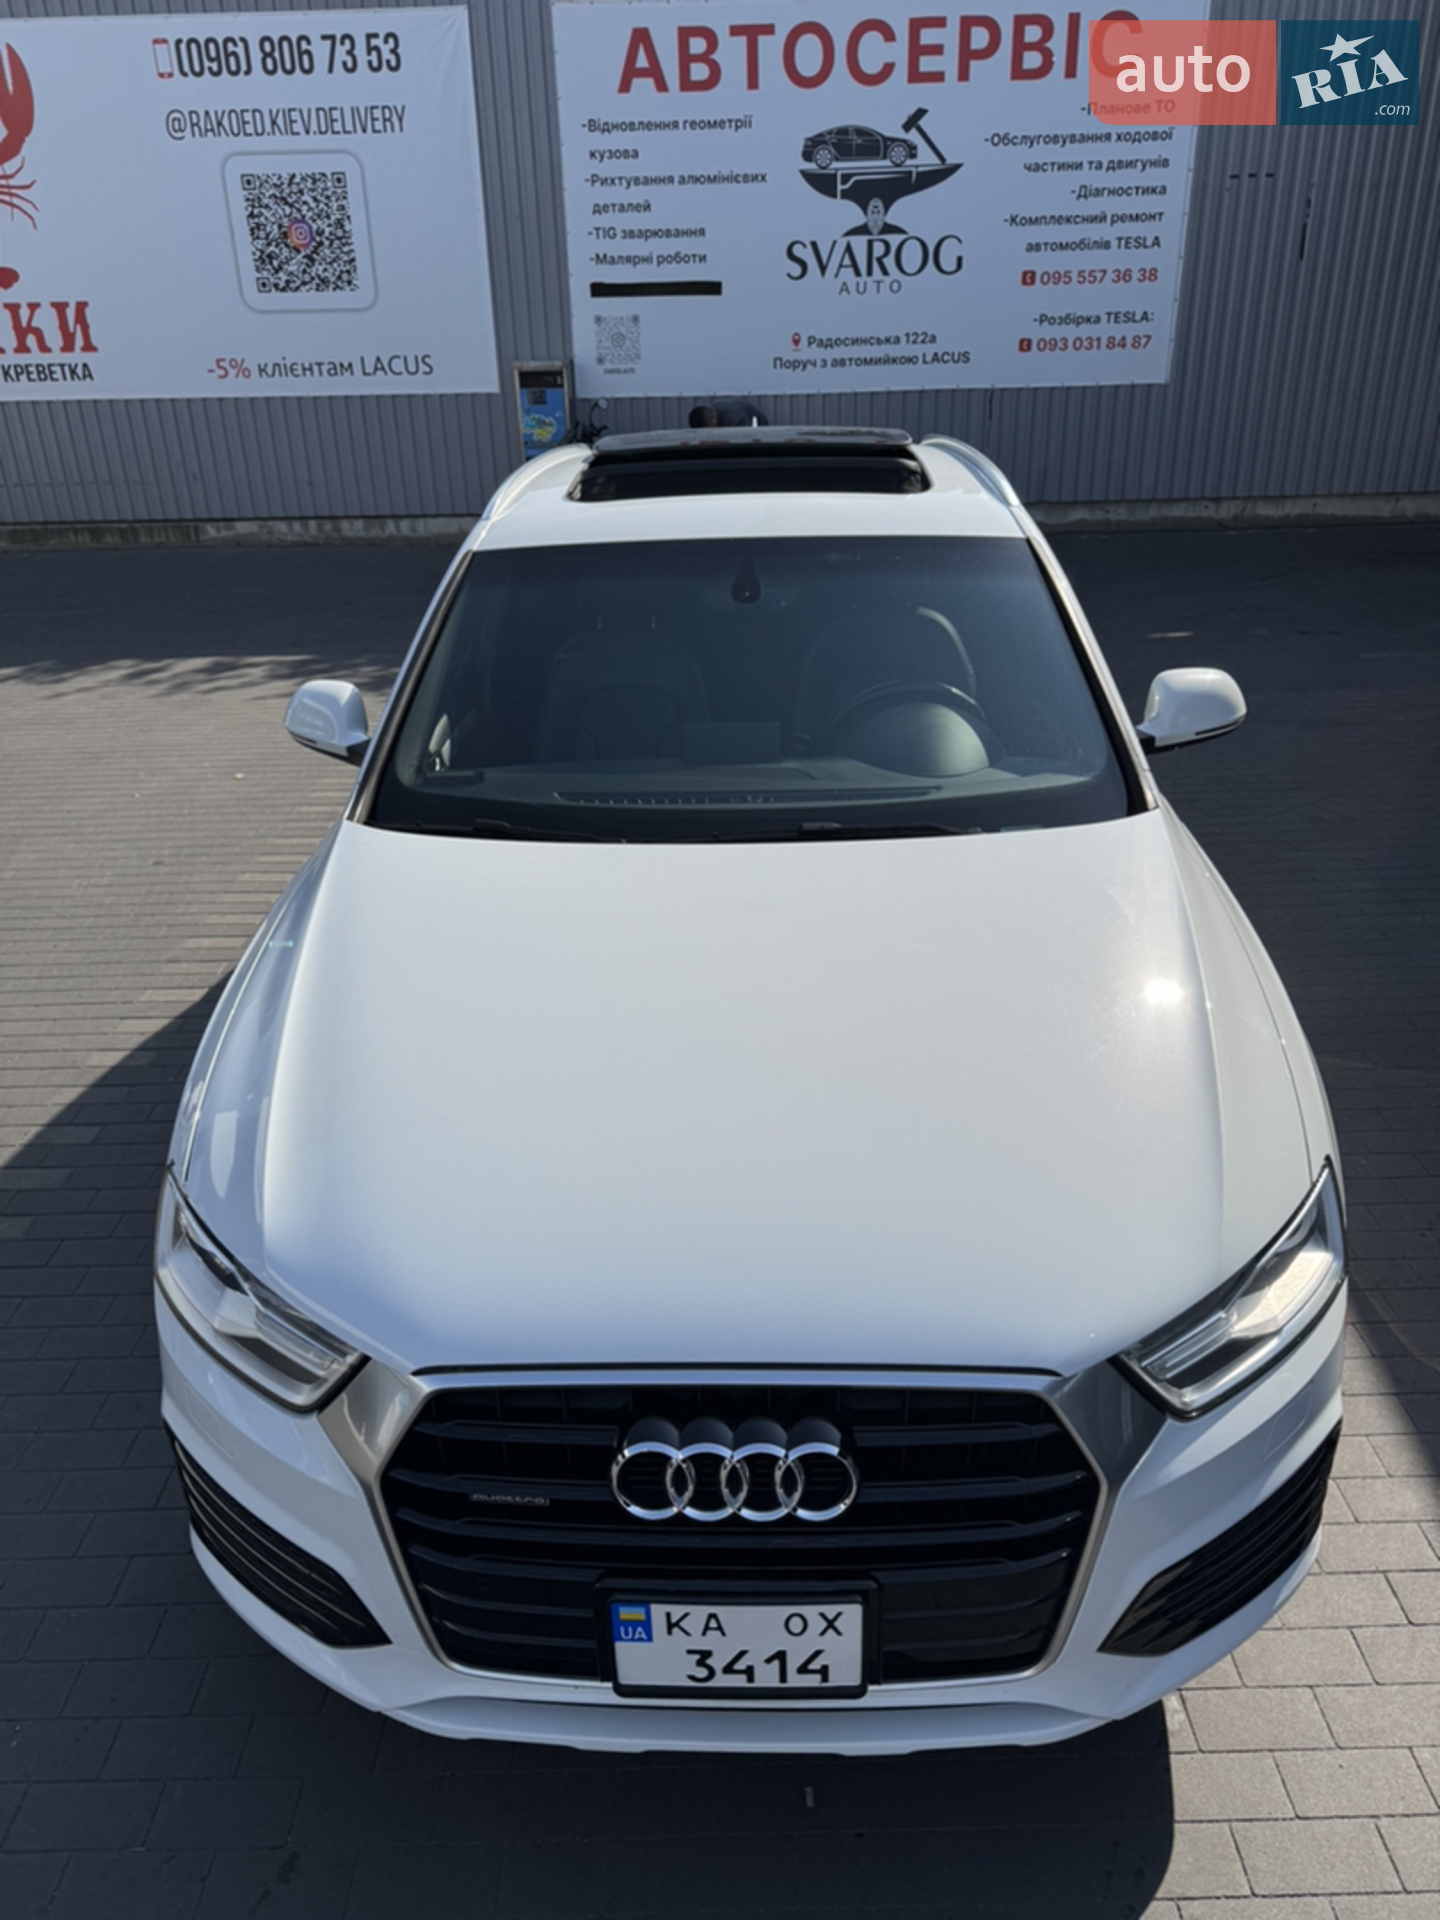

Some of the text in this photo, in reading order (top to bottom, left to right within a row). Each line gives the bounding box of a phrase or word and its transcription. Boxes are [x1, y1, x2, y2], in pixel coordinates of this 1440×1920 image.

[174, 31, 402, 78] (096) 806 73 53
[617, 10, 1143, 94] АВТОСЕРВІС
[165, 104, 406, 141] @RAKOED.KIEV.DELIVERY
[581, 114, 753, 134] -Відновлення геометрії
[984, 126, 1175, 149] -Обслуговування ходової
[589, 148, 640, 163] кузова
[1023, 154, 1170, 173] частини та двигунів
[584, 173, 675, 190] -Рихтування
[1070, 183, 1167, 201] -Діагностика
[592, 199, 652, 216] деталей
[1003, 211, 1165, 227] -Комплексний ремонт
[587, 226, 706, 242] -TIG зварювання
[1025, 235, 1162, 253] автомобілів TESLA
[589, 251, 708, 267] -Малярні роботи
[785, 234, 964, 281] SVAROG
[1039, 267, 1159, 286] 095 557 36 38
[838, 279, 902, 296] AUTO
[0, 301, 98, 354] КИ
[1033, 310, 1155, 328] -Розбірка TESLA:
[807, 331, 937, 350] Радосинська 122а
[1036, 334, 1152, 352] 093 031 84 87
[206, 354, 434, 379] -5% клієнтам LACUS
[773, 350, 971, 372] Поруч з автомийкою LACUS
[1, 362, 95, 383] КРЕВЕТКА
[619, 1626, 648, 1640] UA
[665, 1611, 843, 1637] KA OX
[685, 1649, 830, 1684] 3414
